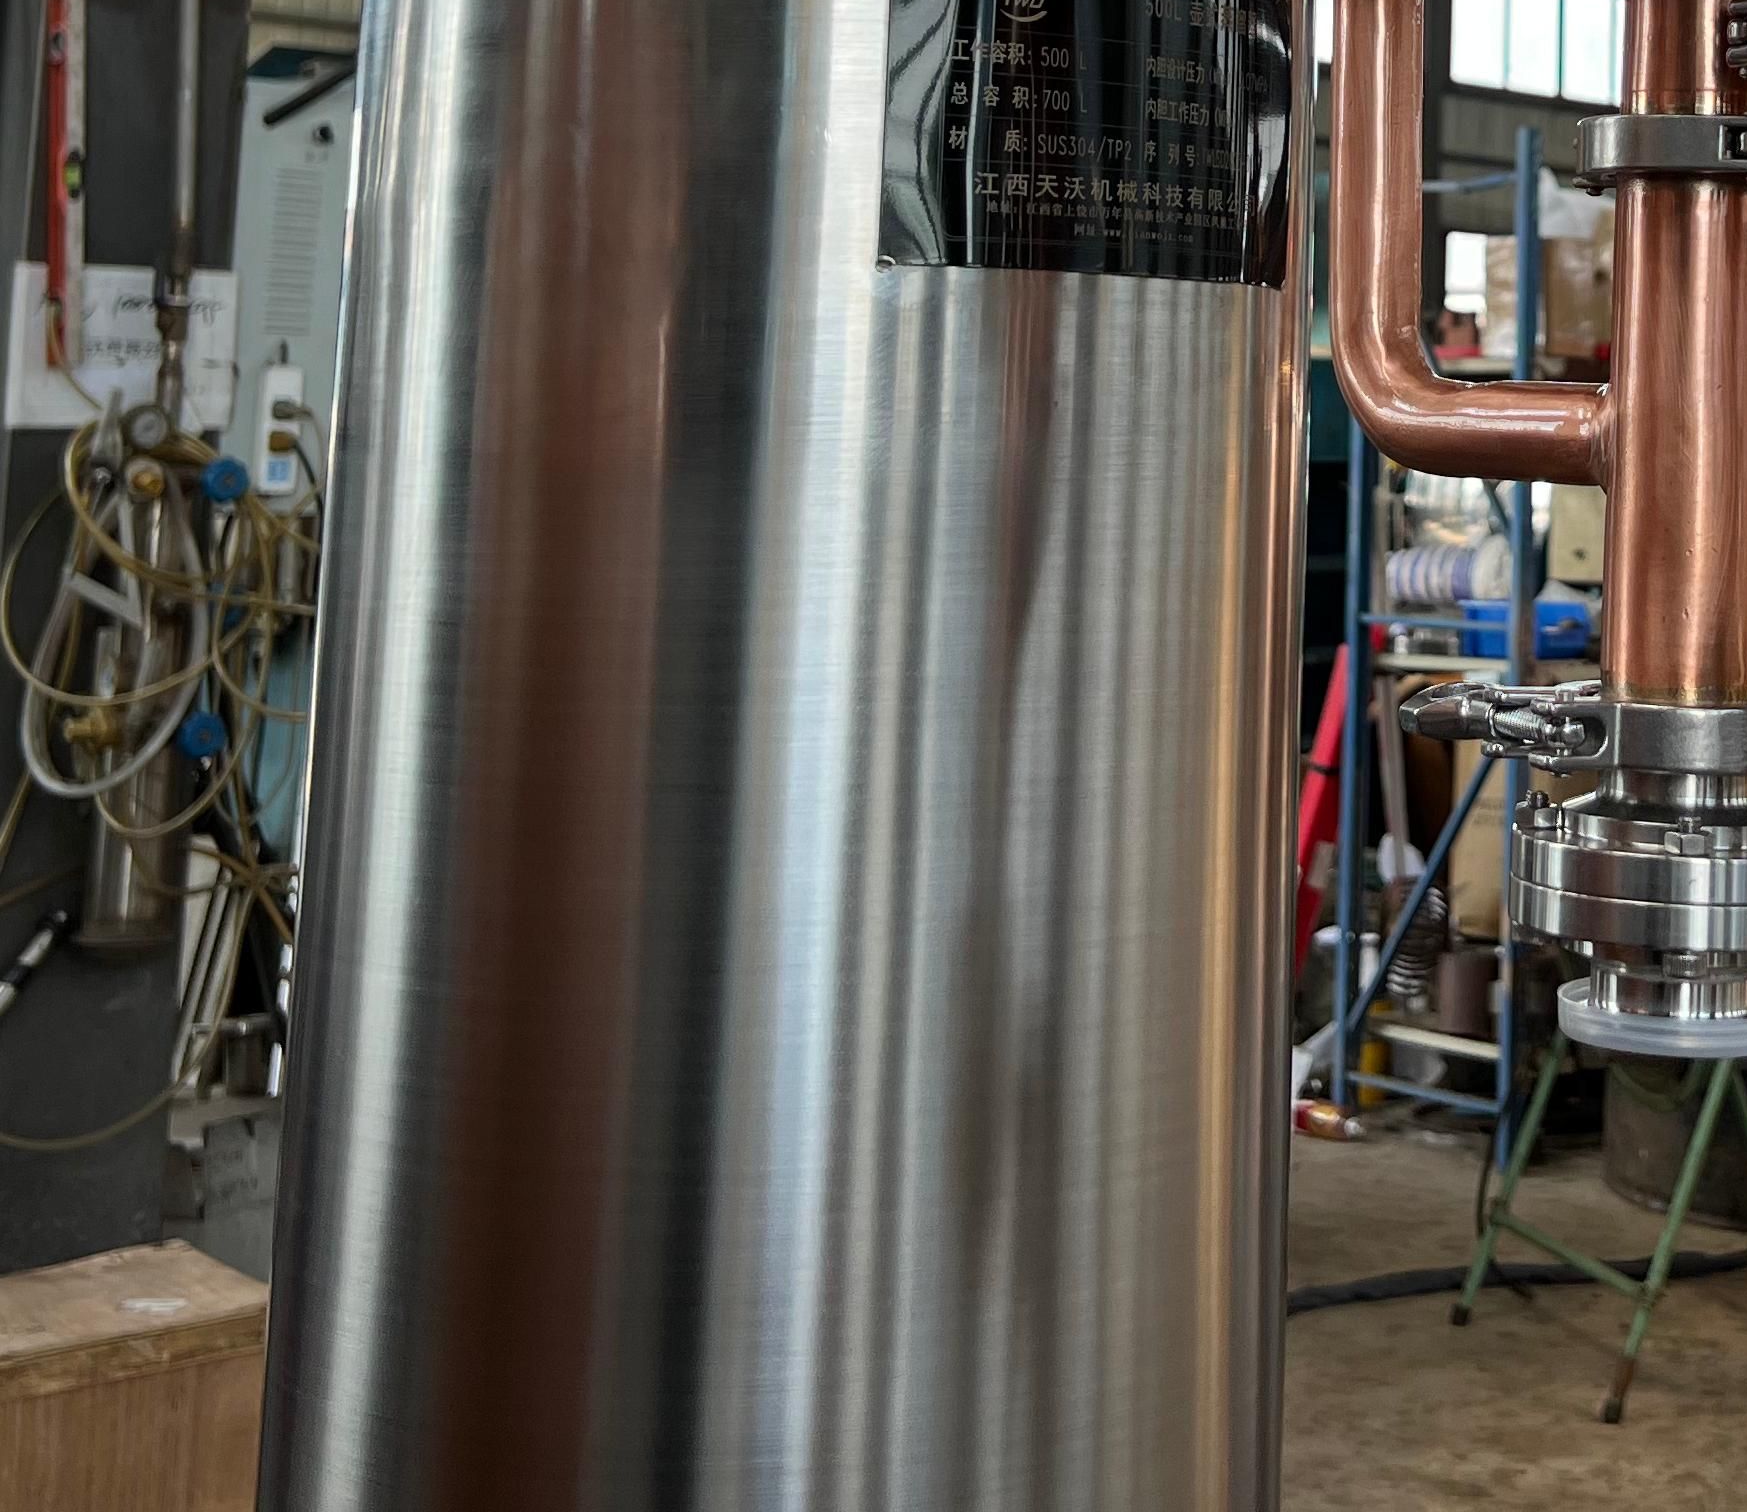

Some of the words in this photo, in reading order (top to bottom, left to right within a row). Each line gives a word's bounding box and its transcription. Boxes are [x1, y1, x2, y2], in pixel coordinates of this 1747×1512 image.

[1040, 45, 1070, 69] 500
[1079, 51, 1088, 71] L
[1043, 89, 1071, 112] 700
[1080, 93, 1088, 113] L
[1037, 134, 1132, 162] SUS304/TP2
